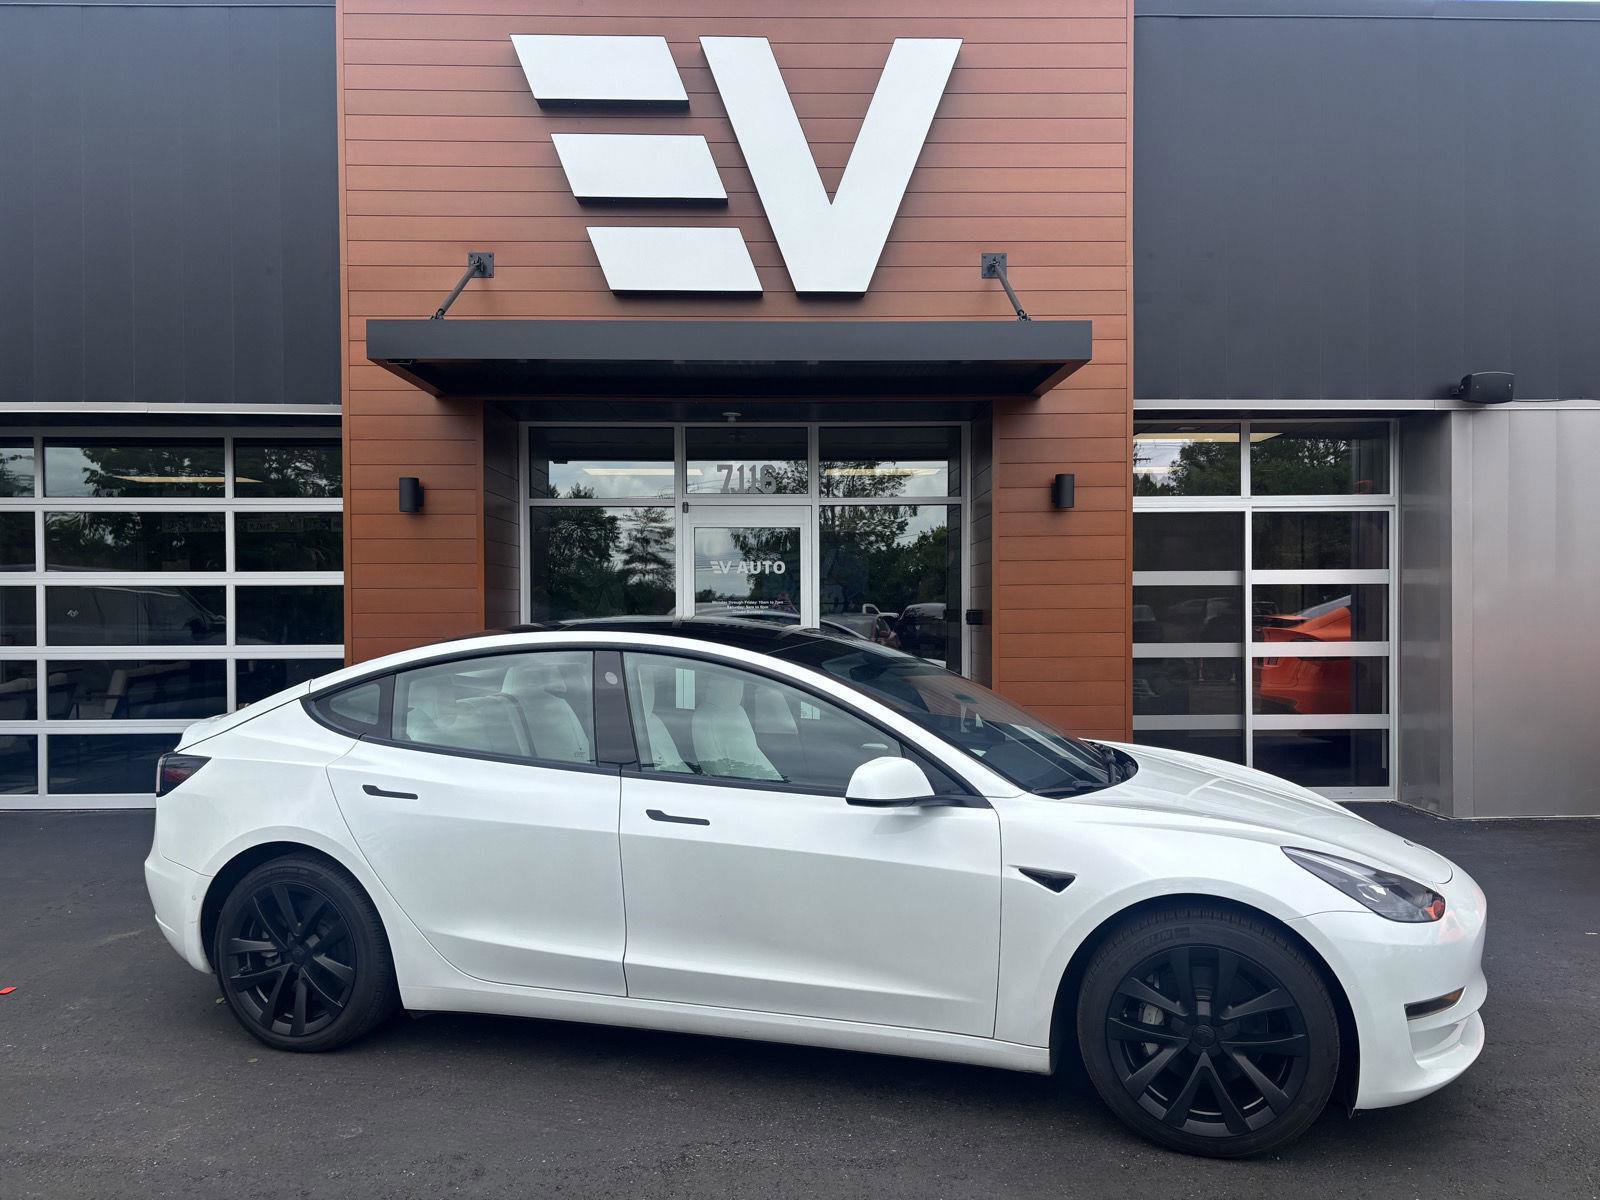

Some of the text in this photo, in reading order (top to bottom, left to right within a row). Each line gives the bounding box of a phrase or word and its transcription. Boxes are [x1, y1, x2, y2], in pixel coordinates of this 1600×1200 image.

[510, 34, 964, 296] EV
[716, 464, 777, 494] 7116
[710, 560, 786, 574] EV AUTO
